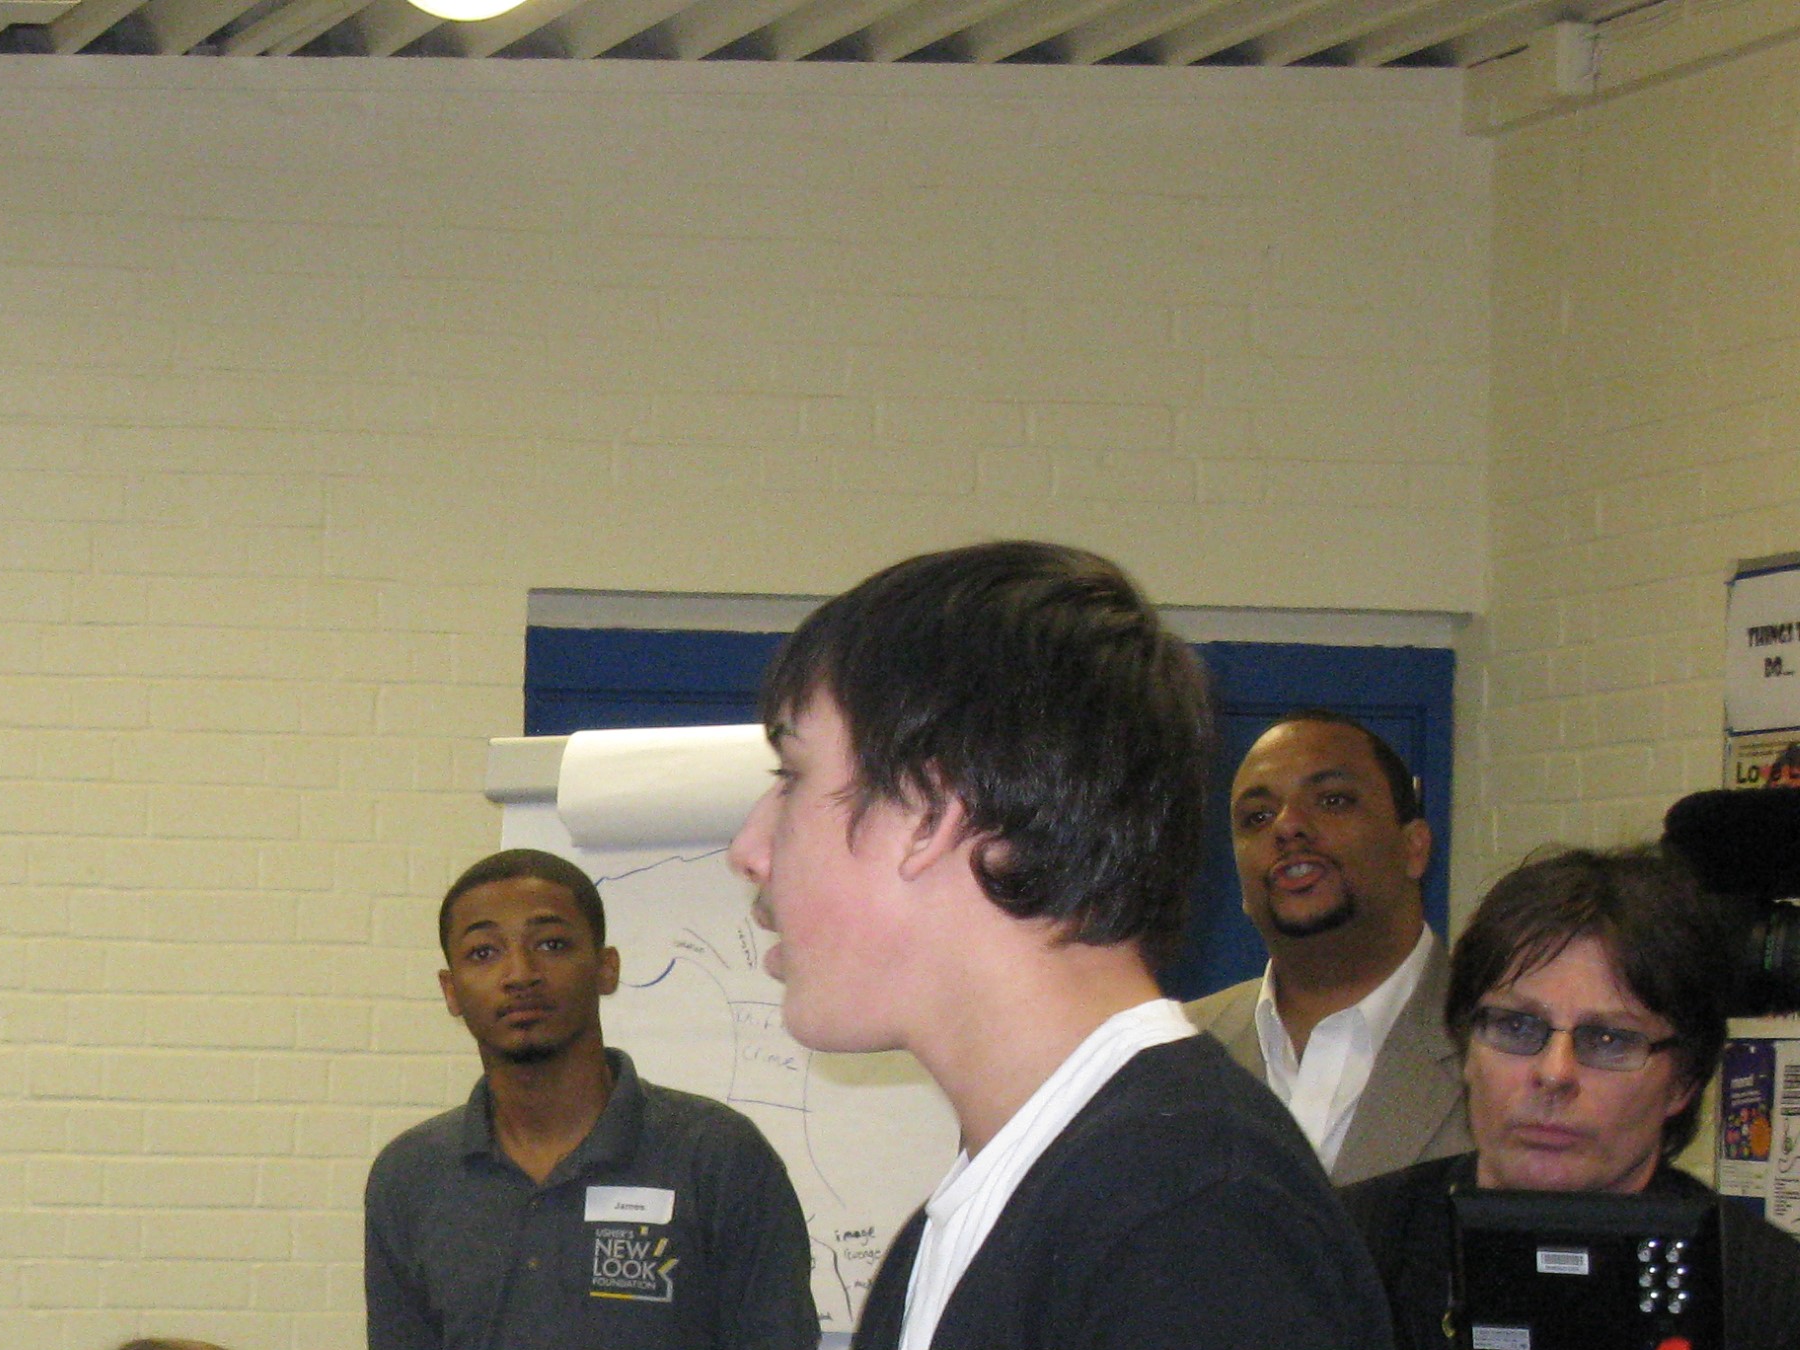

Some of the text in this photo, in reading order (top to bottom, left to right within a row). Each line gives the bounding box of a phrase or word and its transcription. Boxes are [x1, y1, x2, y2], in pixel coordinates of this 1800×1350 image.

[615, 1202, 646, 1211] James
[595, 1238, 651, 1260] NEW
[593, 1258, 657, 1281] LOOK
